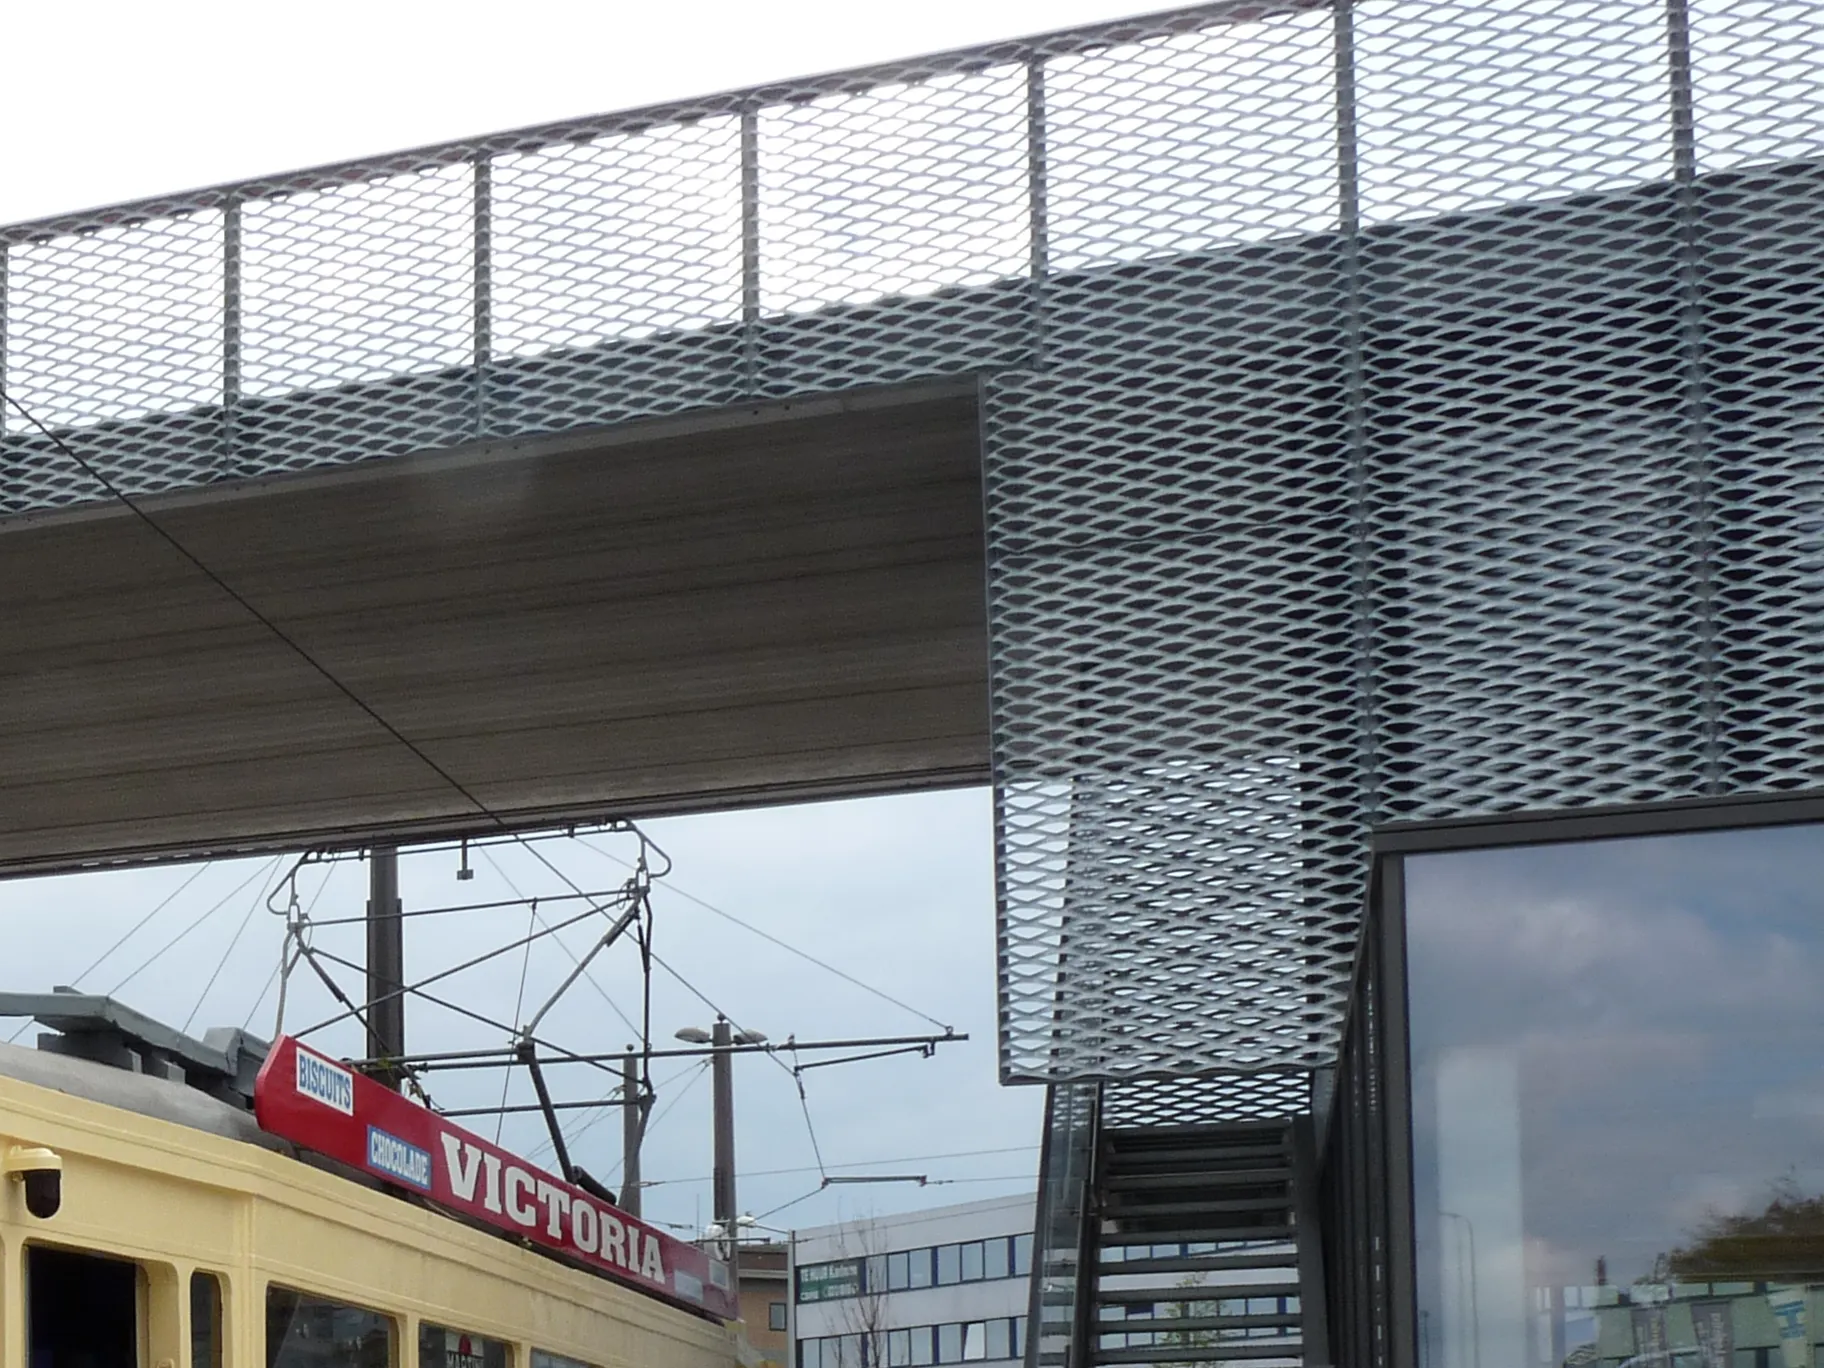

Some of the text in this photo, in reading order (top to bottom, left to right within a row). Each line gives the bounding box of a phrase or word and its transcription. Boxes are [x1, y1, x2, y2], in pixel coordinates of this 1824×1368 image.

[299, 1054, 351, 1110] BISCUITS
[371, 1130, 429, 1186] CHOCOLADE
[441, 1131, 666, 1285] VICTORIA
